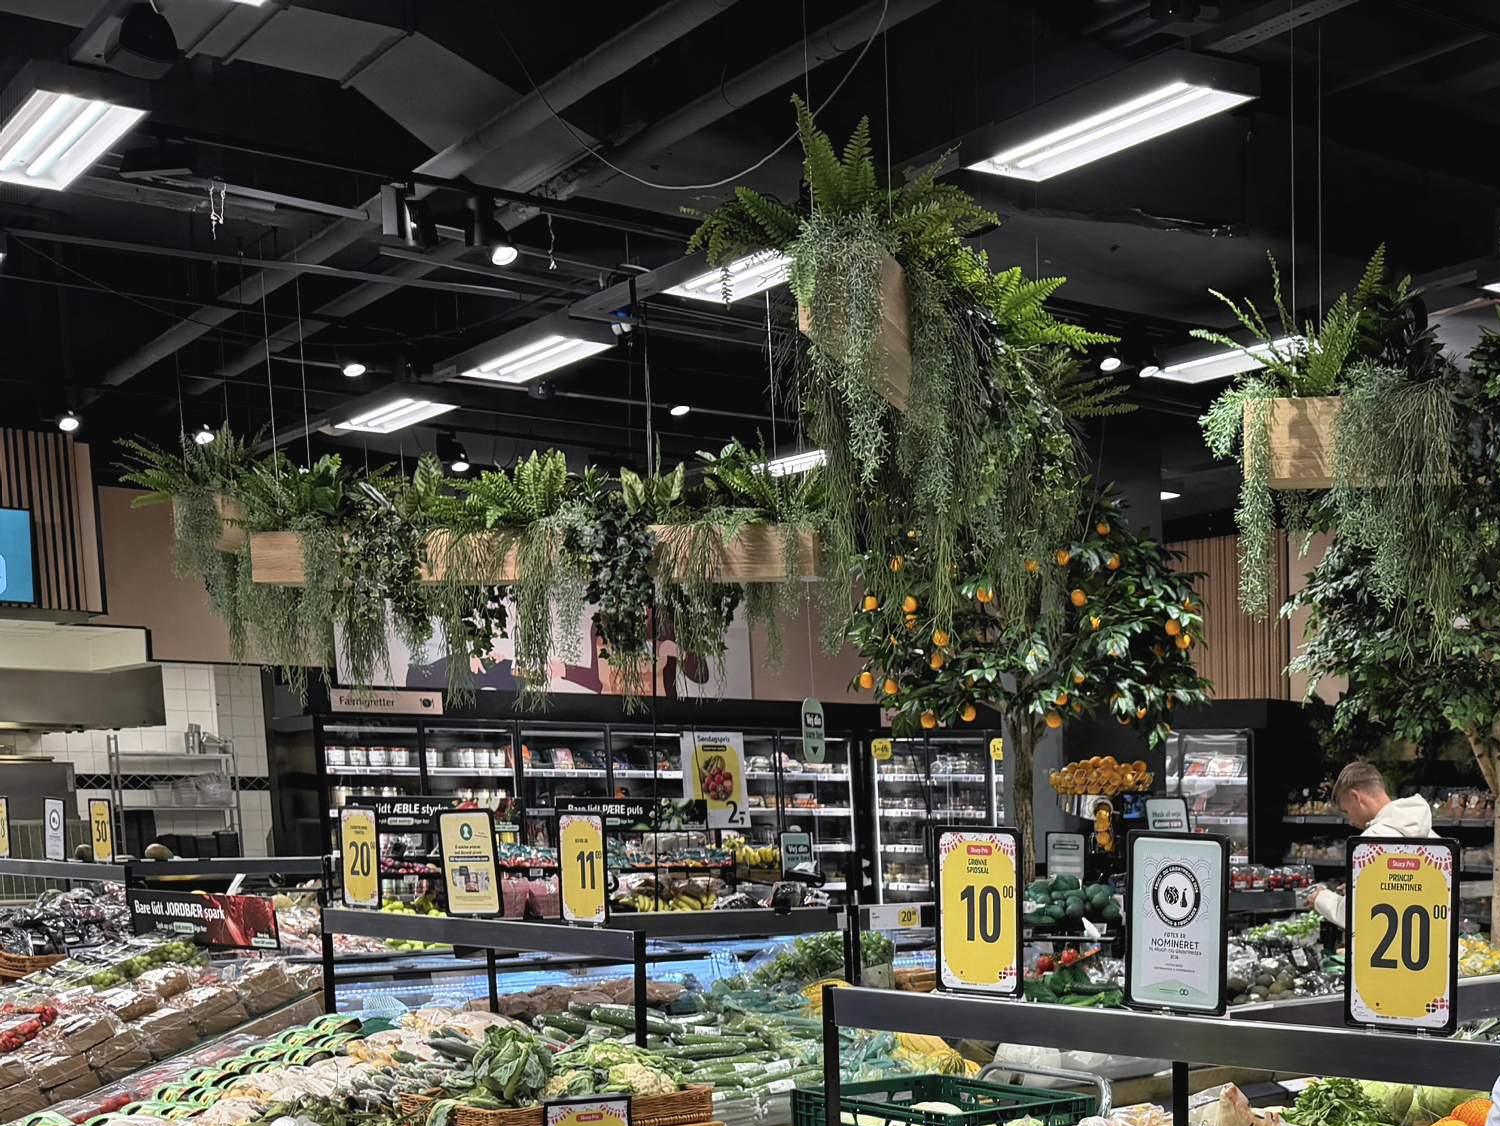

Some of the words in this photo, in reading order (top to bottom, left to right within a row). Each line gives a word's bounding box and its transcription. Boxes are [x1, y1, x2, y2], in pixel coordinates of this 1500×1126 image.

[393, 803, 420, 814] ÆBLE
[602, 804, 625, 814] PÆRE
[626, 805, 643, 816] puls
[94, 820, 107, 842] 30
[349, 841, 371, 876] 20
[576, 851, 595, 889] 11
[1388, 874, 1414, 882] PRINCIP
[1380, 882, 1422, 892] CLEMENTINER
[134, 900, 151, 914] Bare
[151, 901, 164, 916] lidt
[165, 902, 203, 918] JORDBÆR
[204, 906, 226, 922] spark
[901, 911, 912, 922] 20
[960, 885, 1001, 943] 10
[1151, 938, 1200, 950] NOMINERET
[1370, 903, 1431, 972] 20
